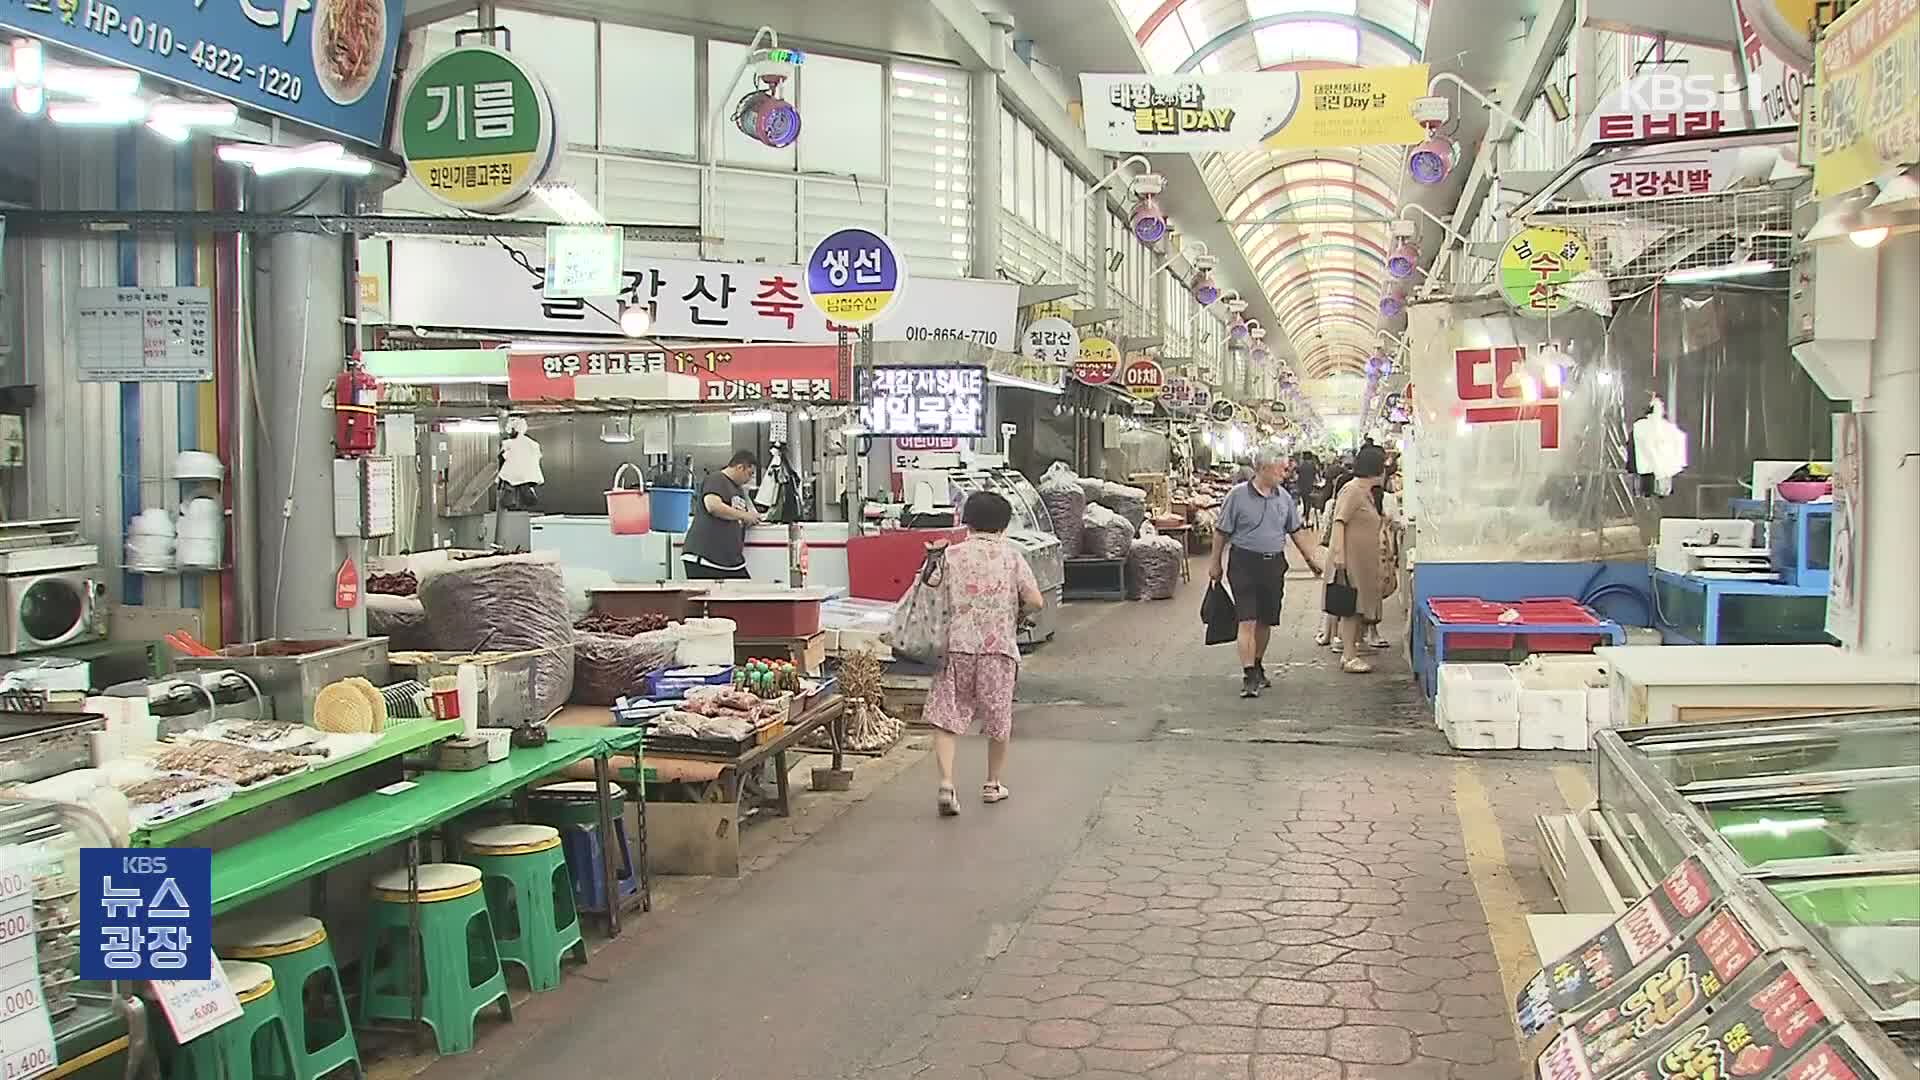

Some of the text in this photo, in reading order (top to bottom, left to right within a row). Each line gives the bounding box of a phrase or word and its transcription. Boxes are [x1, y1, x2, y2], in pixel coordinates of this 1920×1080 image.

[426, 81, 515, 141] 기름
[1343, 95, 1370, 110] Day
[1180, 109, 1235, 132] DAY
[430, 163, 512, 188] 회인기름고추집
[1610, 169, 1712, 198] 건강신발
[822, 248, 882, 288] 생선
[1030, 332, 1071, 346] 칠갑산
[543, 356, 580, 378] 한우
[1127, 368, 1157, 384] 야채
[1455, 346, 1560, 450] 떡
